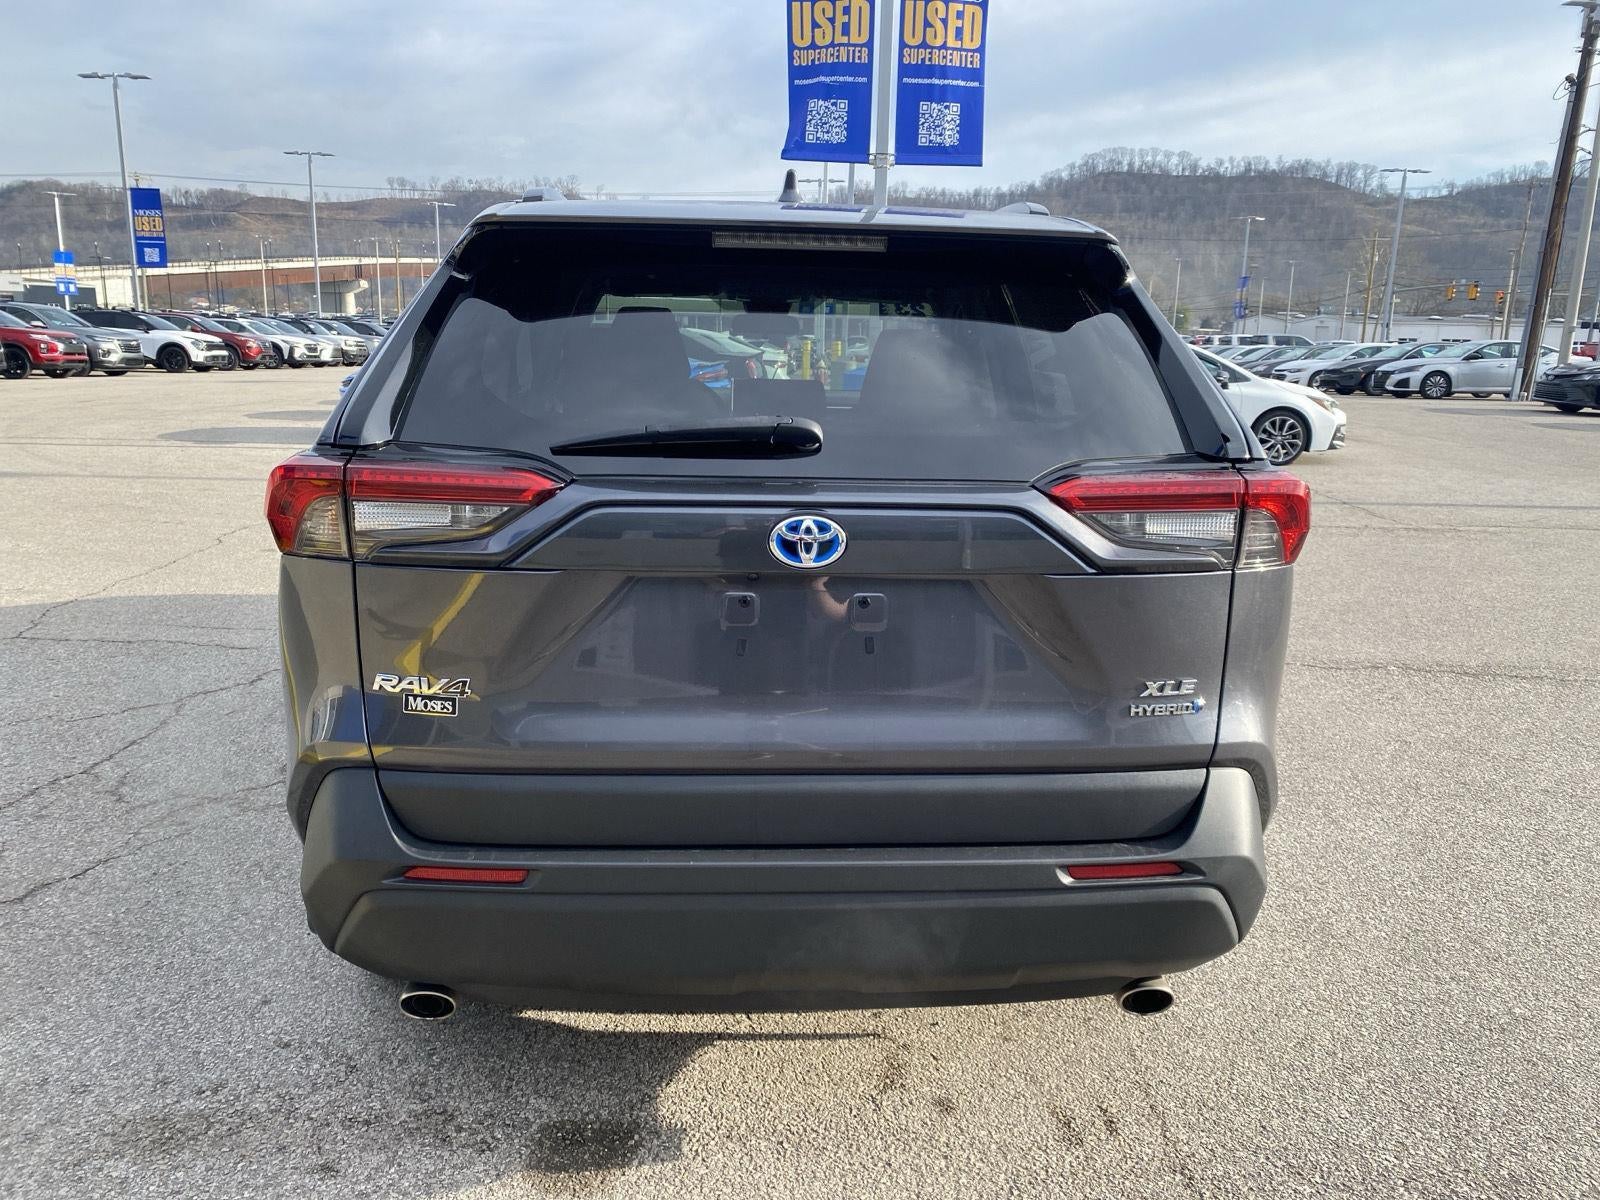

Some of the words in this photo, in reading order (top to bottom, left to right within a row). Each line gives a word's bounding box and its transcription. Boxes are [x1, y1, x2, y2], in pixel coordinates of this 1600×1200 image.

[792, 0, 870, 48] USED
[904, 0, 983, 49] USED
[793, 46, 869, 66] SUPERCENTER
[903, 48, 980, 68] SUPERCENTER
[135, 217, 163, 231] USED
[373, 674, 471, 698] RAV4
[1140, 679, 1197, 697] XLE
[1130, 703, 1193, 717] HYBRID
